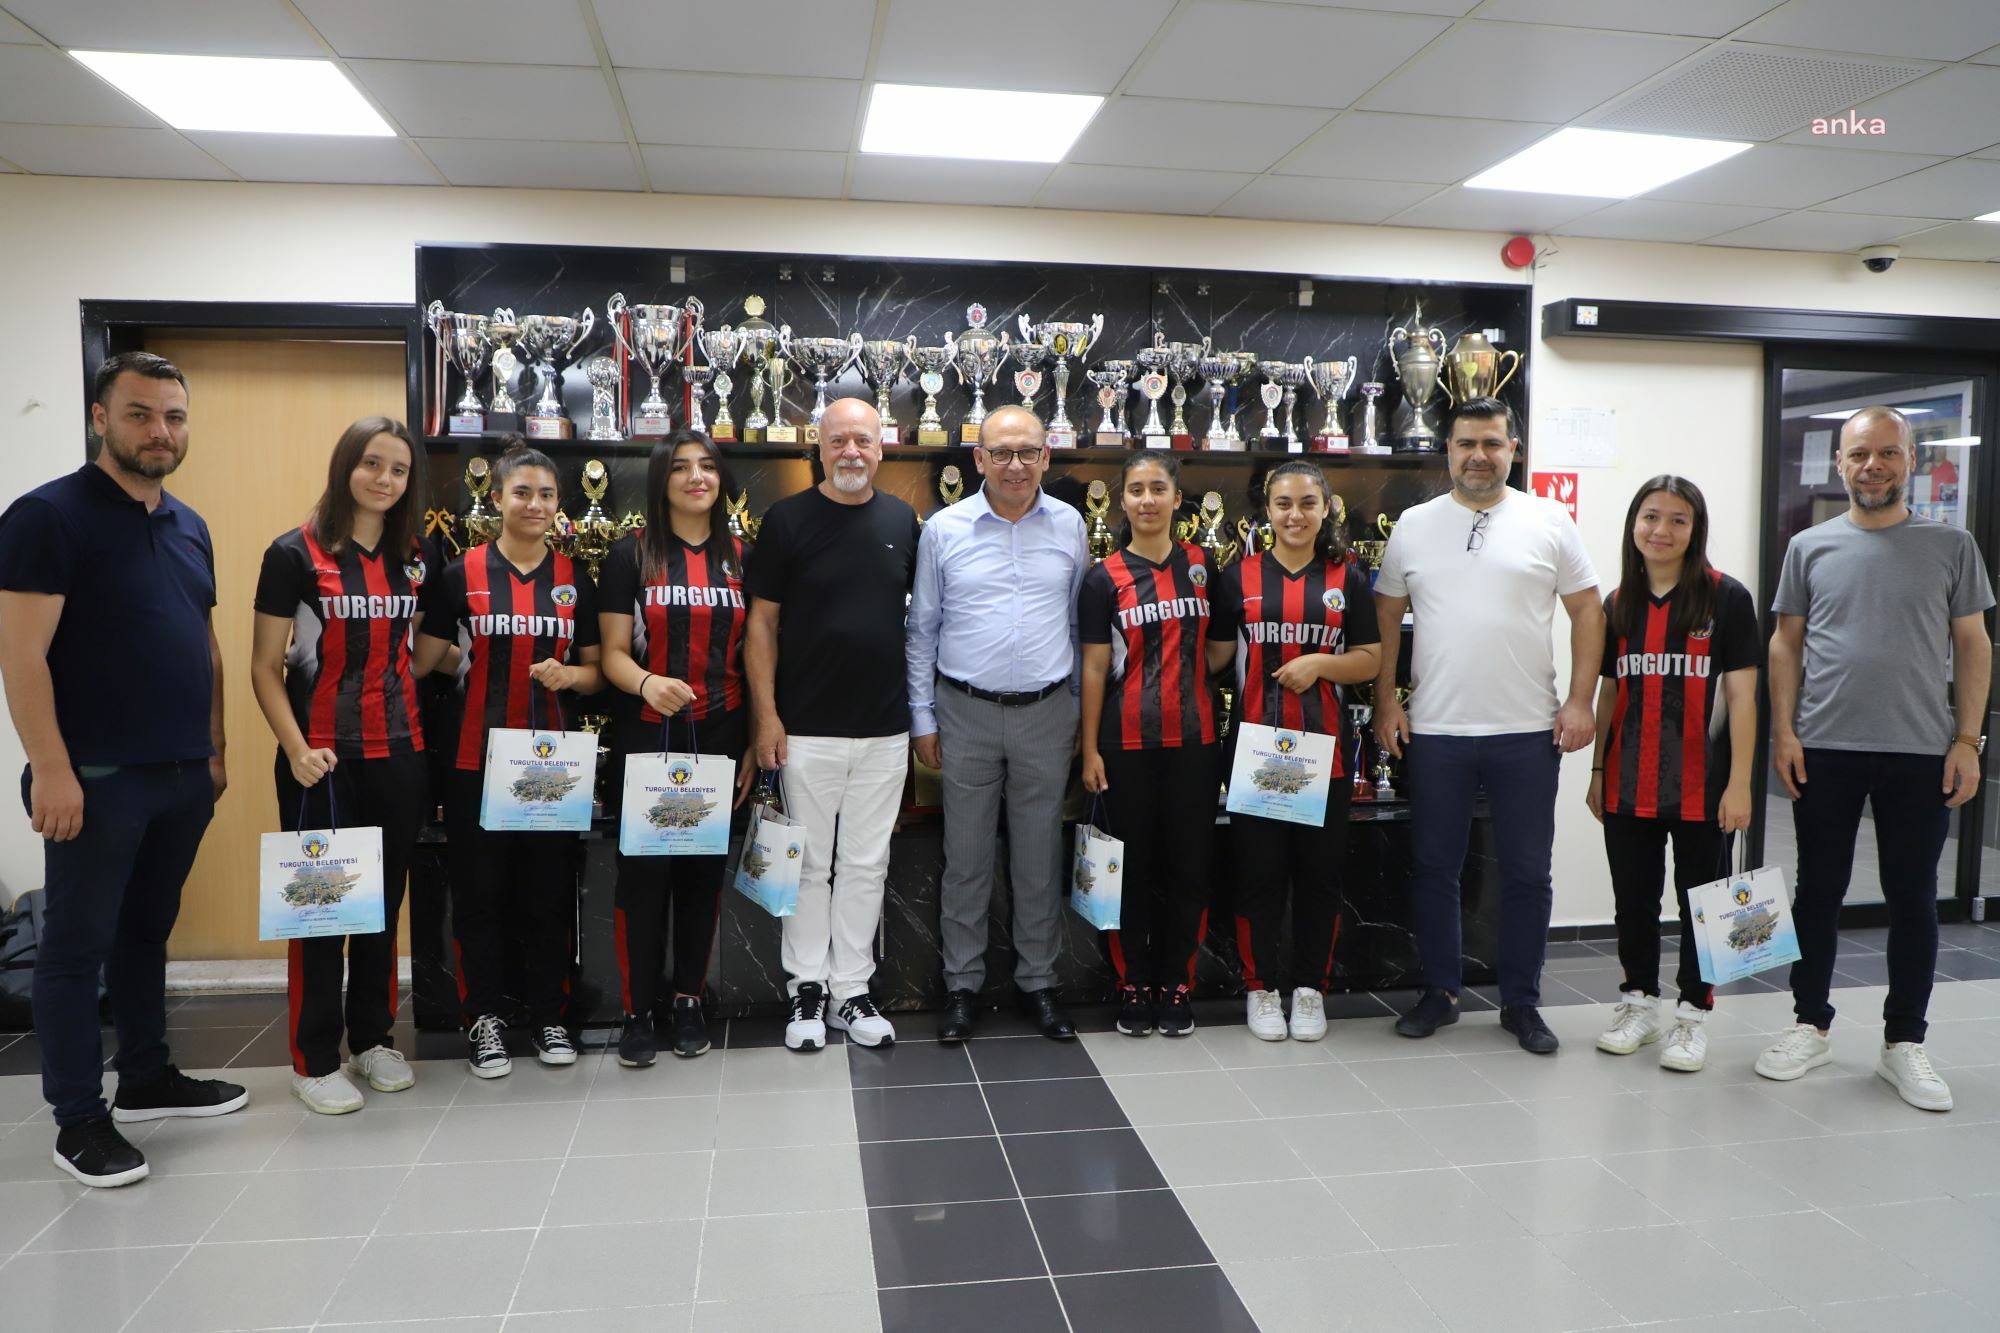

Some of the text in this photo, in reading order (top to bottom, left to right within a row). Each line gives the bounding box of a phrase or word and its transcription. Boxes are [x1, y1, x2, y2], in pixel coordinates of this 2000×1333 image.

[468, 613, 576, 640] TURGUTLU
[1117, 597, 1211, 630] TURGUTLU
[1244, 621, 1342, 648] TURGUTLU
[1616, 652, 1712, 679] URGUTLU
[1252, 749, 1284, 760] TURGUTLU
[278, 860, 314, 869] TURGUTLU
